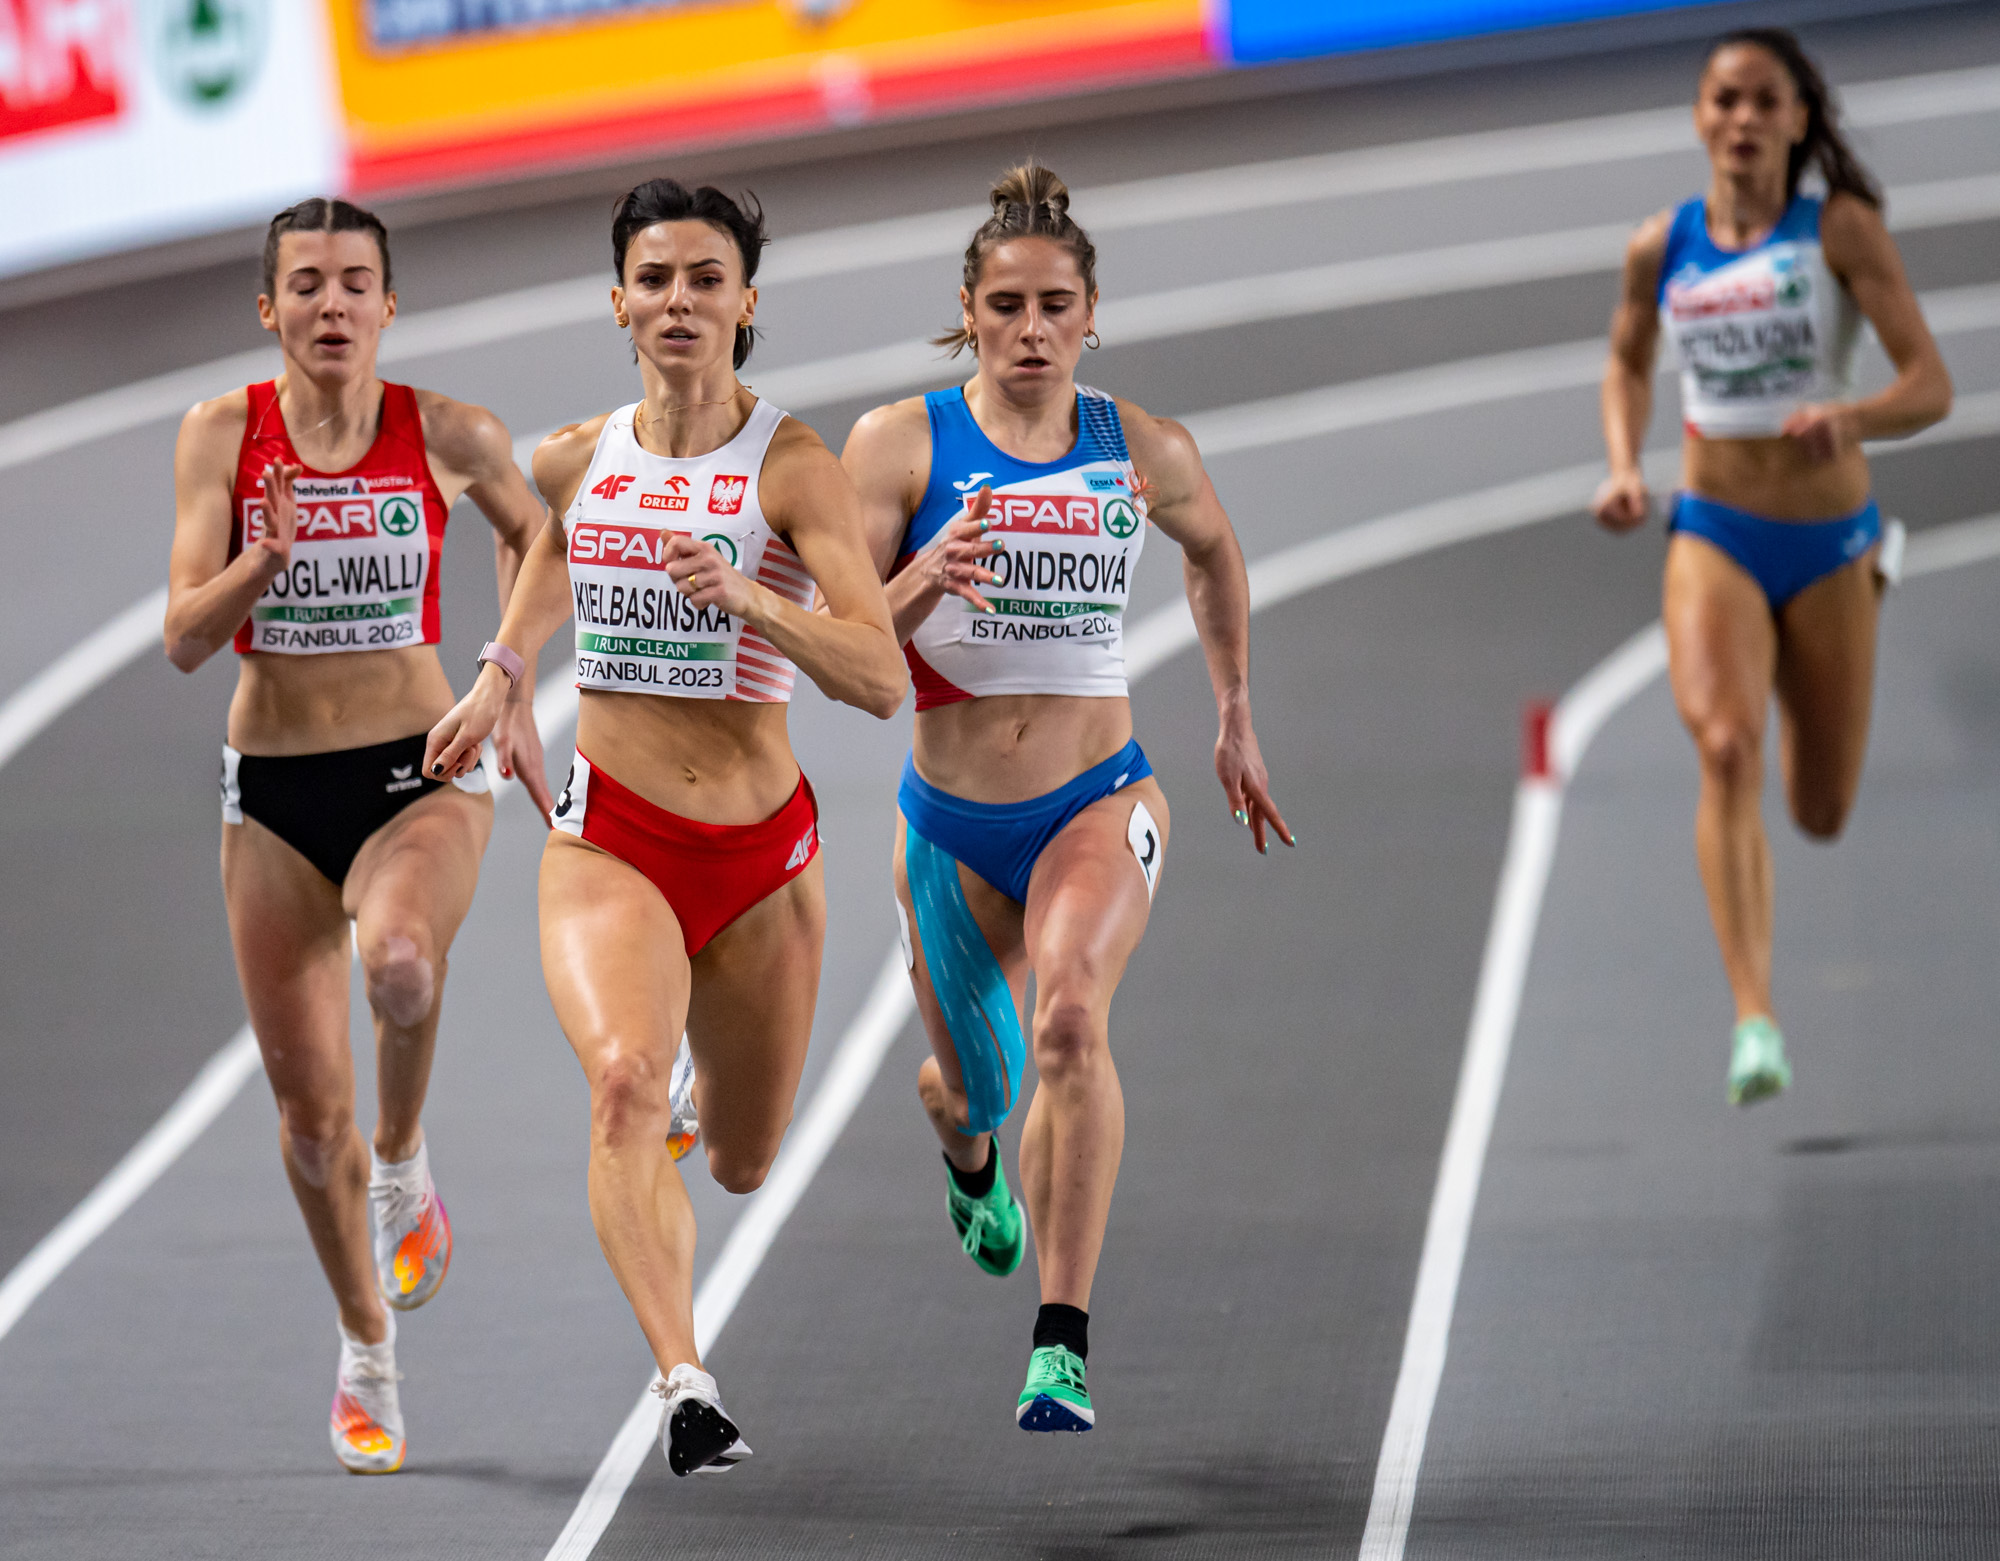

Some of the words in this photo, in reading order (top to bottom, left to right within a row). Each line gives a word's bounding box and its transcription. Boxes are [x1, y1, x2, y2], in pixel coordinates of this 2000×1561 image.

[591, 474, 636, 500] 4F
[642, 496, 686, 510] ORLEN
[573, 528, 664, 565] SPA
[294, 606, 328, 621] RUN
[1009, 600, 1046, 615] RUN
[262, 627, 362, 648] ISTANBUL
[368, 619, 414, 644] 2023
[594, 637, 599, 650] I
[599, 638, 631, 653] RUN
[668, 667, 723, 687] 2023
